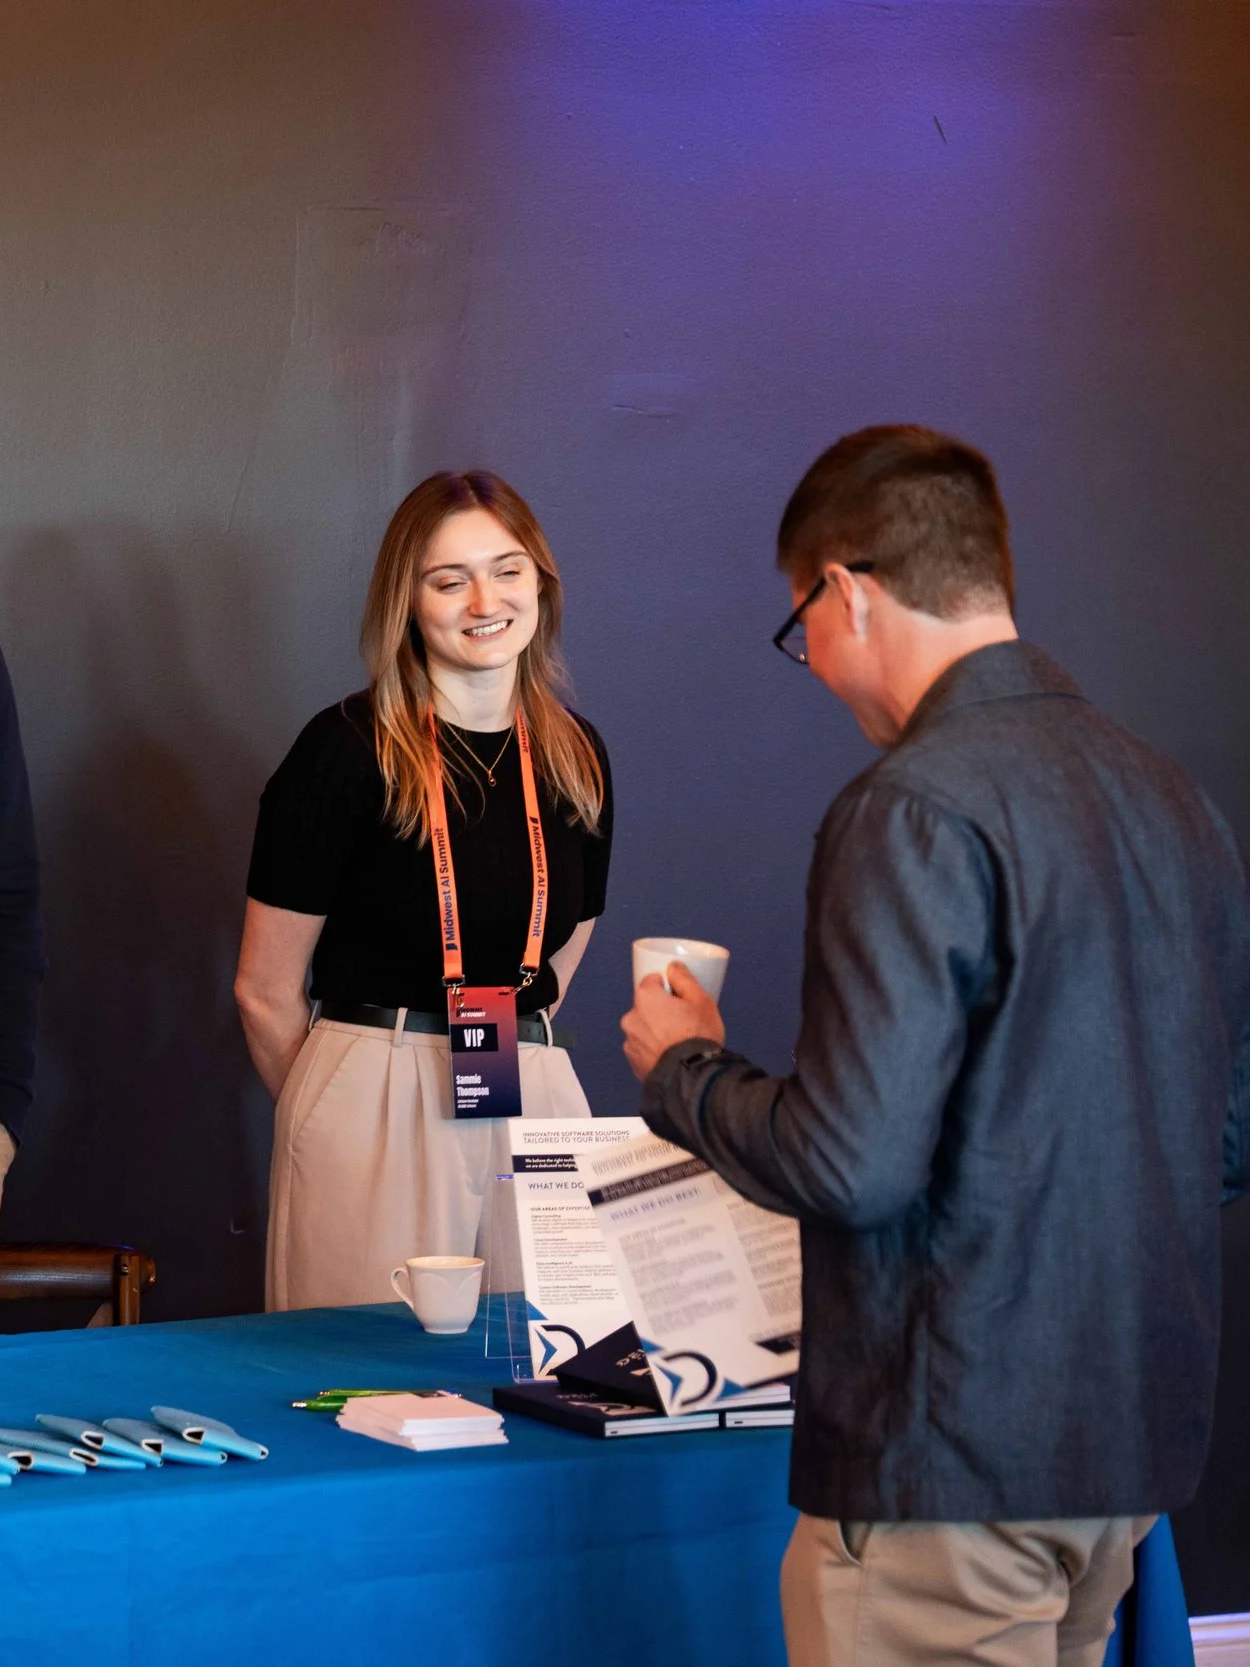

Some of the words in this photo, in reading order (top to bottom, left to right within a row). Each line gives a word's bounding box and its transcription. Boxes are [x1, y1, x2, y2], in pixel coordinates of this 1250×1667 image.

[434, 828, 449, 873] Summit
[532, 826, 544, 873] Midwest
[440, 876, 450, 888] AI
[537, 875, 545, 888] AI
[442, 890, 455, 941] Midwest
[532, 890, 545, 937] Summit
[464, 1028, 485, 1047] VIP
[456, 1074, 481, 1085] Sammie
[457, 1087, 489, 1097] Thompson
[528, 1182, 553, 1190] WHAT
[556, 1181, 569, 1189] WE
[571, 1181, 584, 1189] DO
